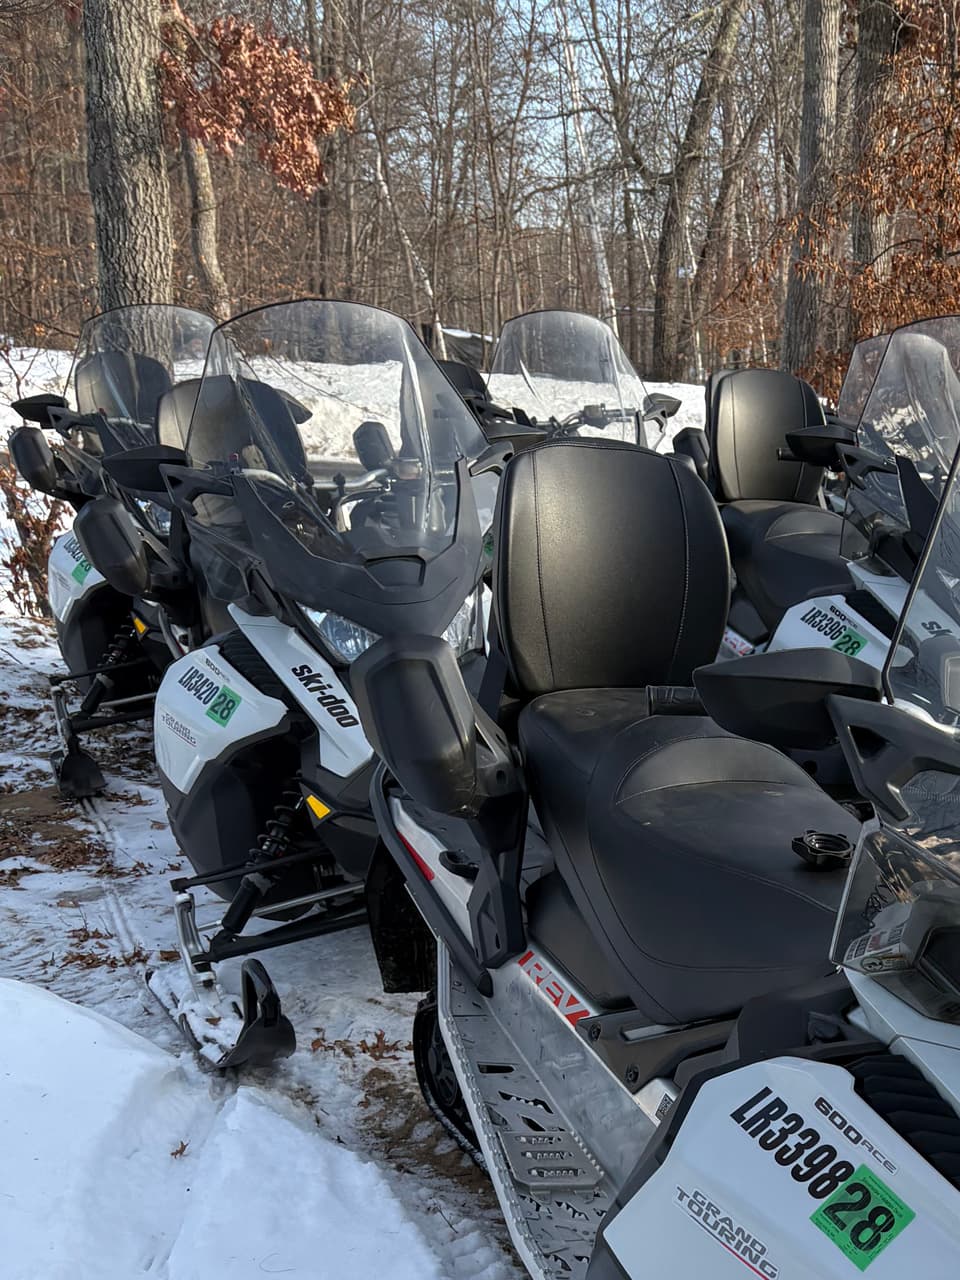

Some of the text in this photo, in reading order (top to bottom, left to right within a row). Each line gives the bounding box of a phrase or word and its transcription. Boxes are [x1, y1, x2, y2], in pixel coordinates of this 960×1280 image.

[800, 606, 847, 641] LR3396
[833, 634, 861, 656] 28
[178, 666, 219, 705] LR3420
[210, 692, 237, 721] 28
[292, 664, 360, 729] ski-doo
[518, 950, 591, 1026] REV
[729, 1086, 856, 1200] LR3398
[676, 1186, 778, 1279] TOURING
[692, 1190, 767, 1256] GRAND
[822, 1182, 896, 1251] 28
